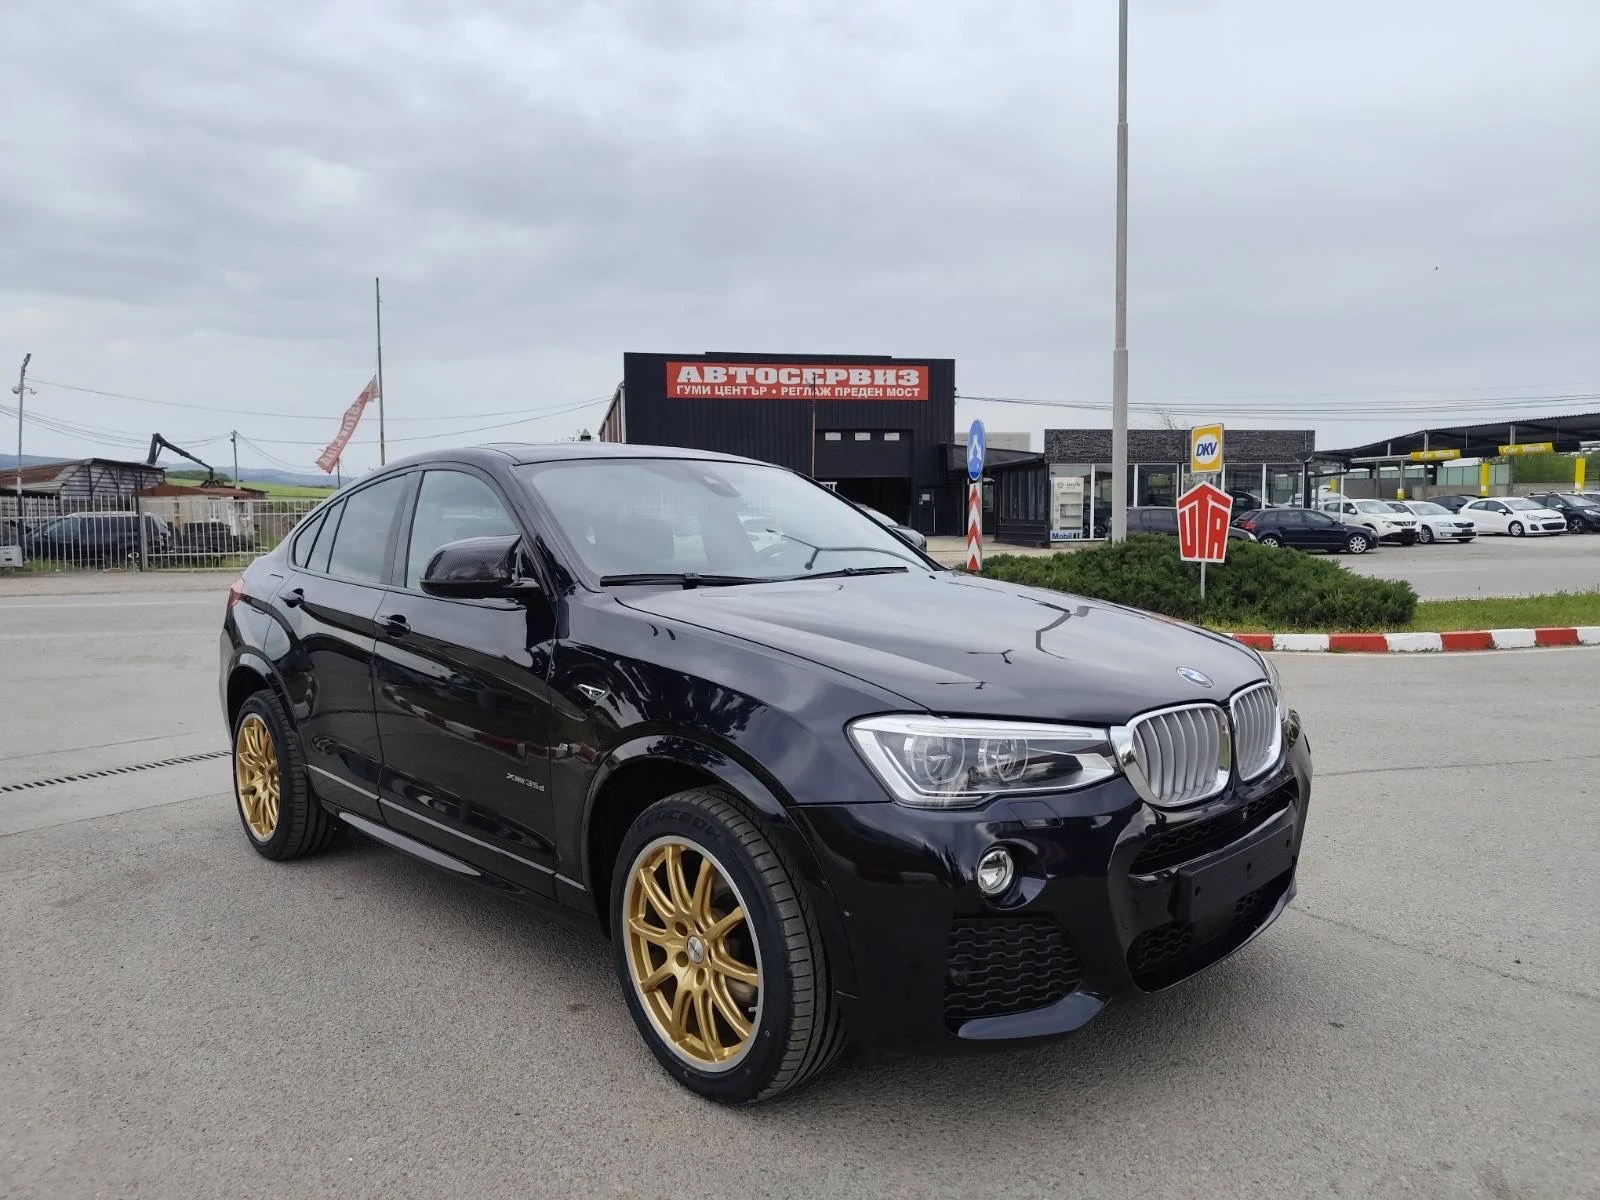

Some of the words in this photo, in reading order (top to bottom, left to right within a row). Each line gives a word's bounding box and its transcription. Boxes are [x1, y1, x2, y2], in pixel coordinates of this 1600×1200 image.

[677, 366, 920, 386] АВТОСЕРВИЗ
[676, 385, 711, 395] ГУМИ
[714, 386, 767, 396] ЦЕНТЪР
[781, 386, 832, 397] РЕГЛАЖ
[835, 387, 883, 398] ПРЕДЕН
[886, 388, 920, 397] МОСТ
[1196, 442, 1217, 456] DKV
[1178, 484, 1231, 560] UTA
